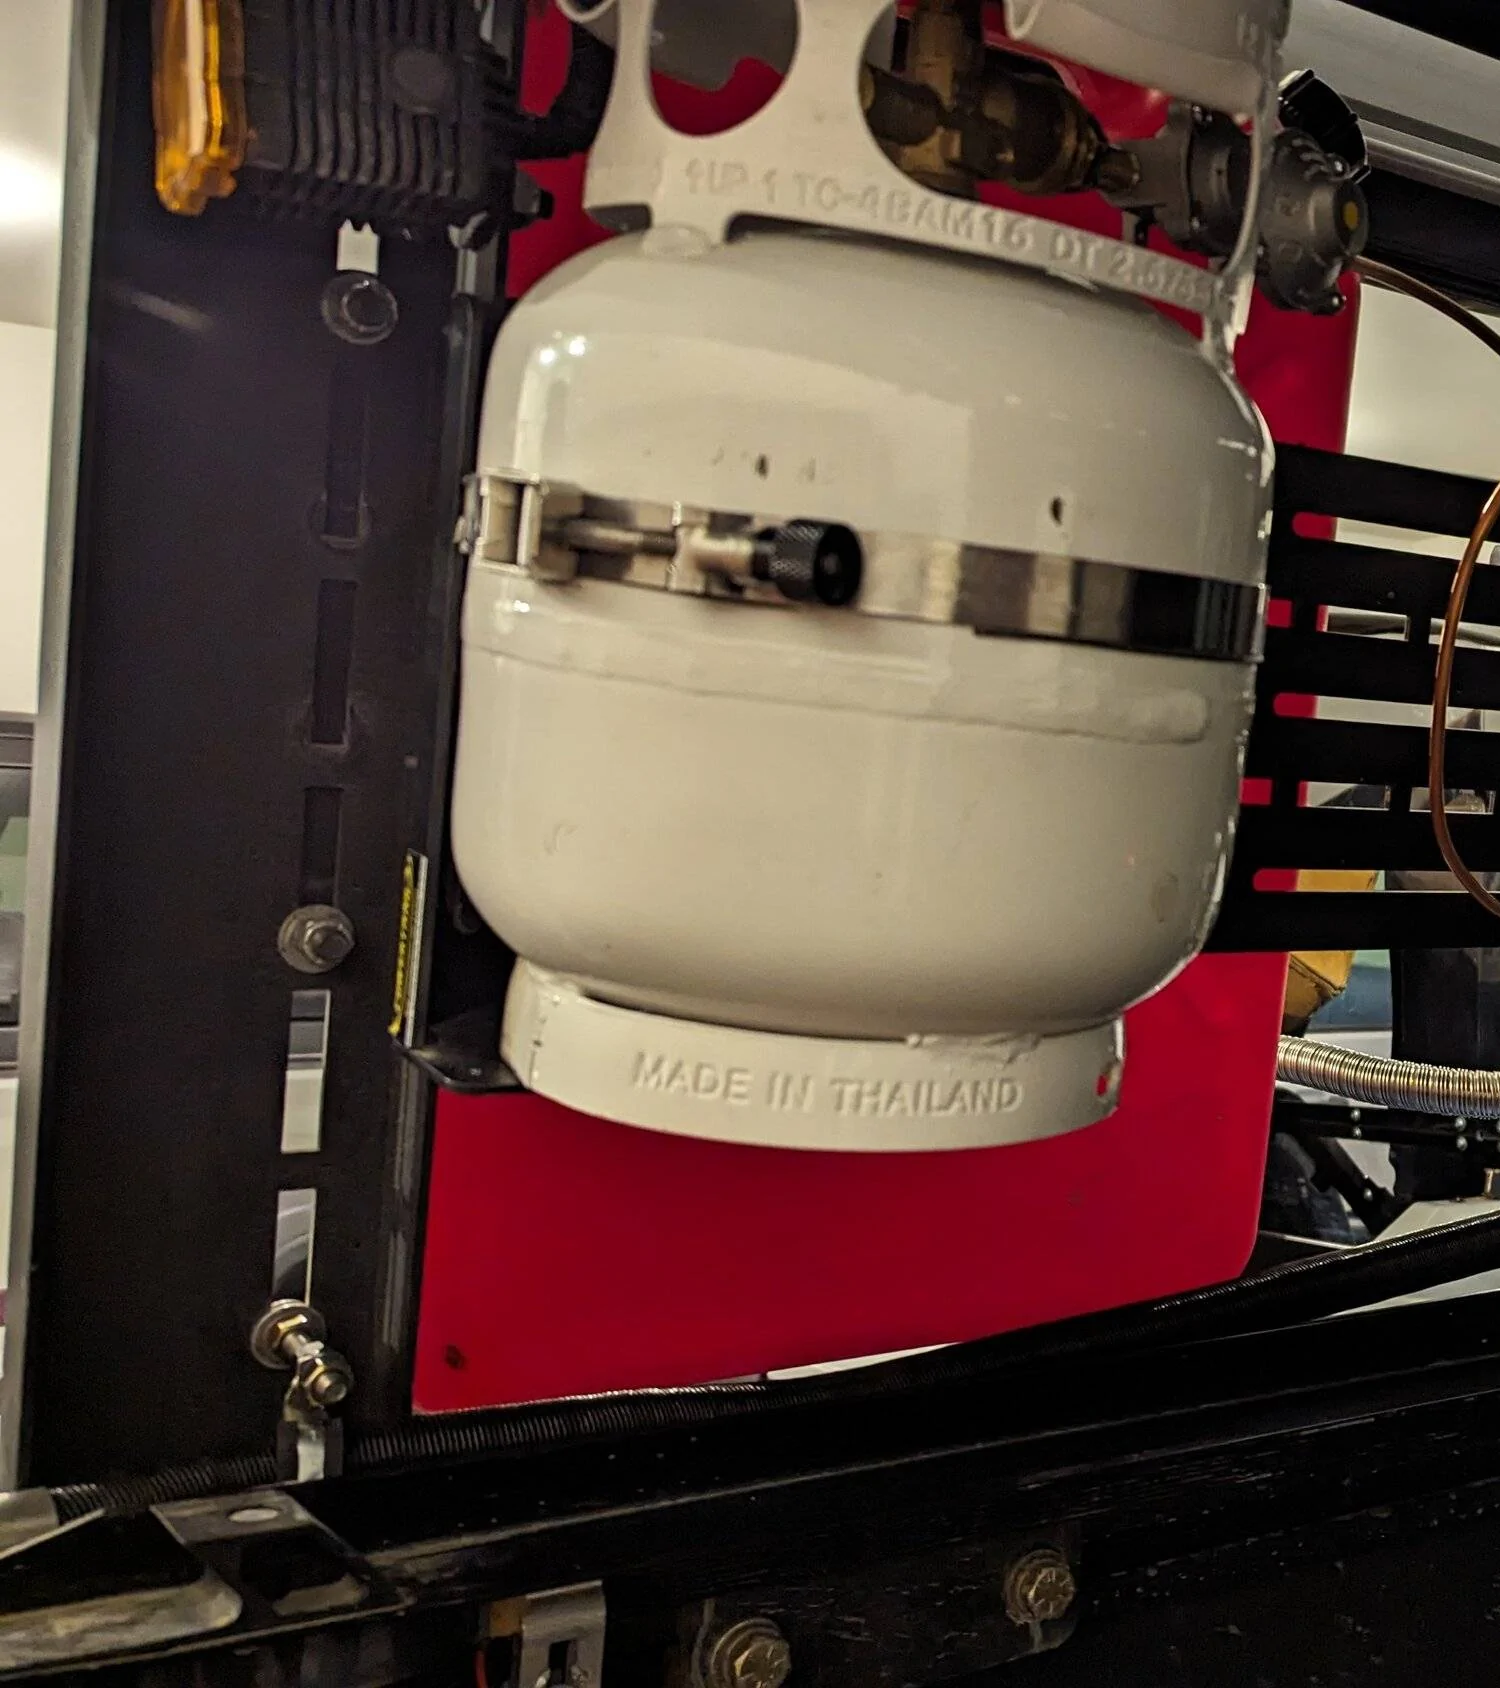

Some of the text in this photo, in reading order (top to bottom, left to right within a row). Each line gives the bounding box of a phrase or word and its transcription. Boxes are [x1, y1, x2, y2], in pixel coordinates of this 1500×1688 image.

[632, 1050, 1024, 1118] MADE IN THAILAND
